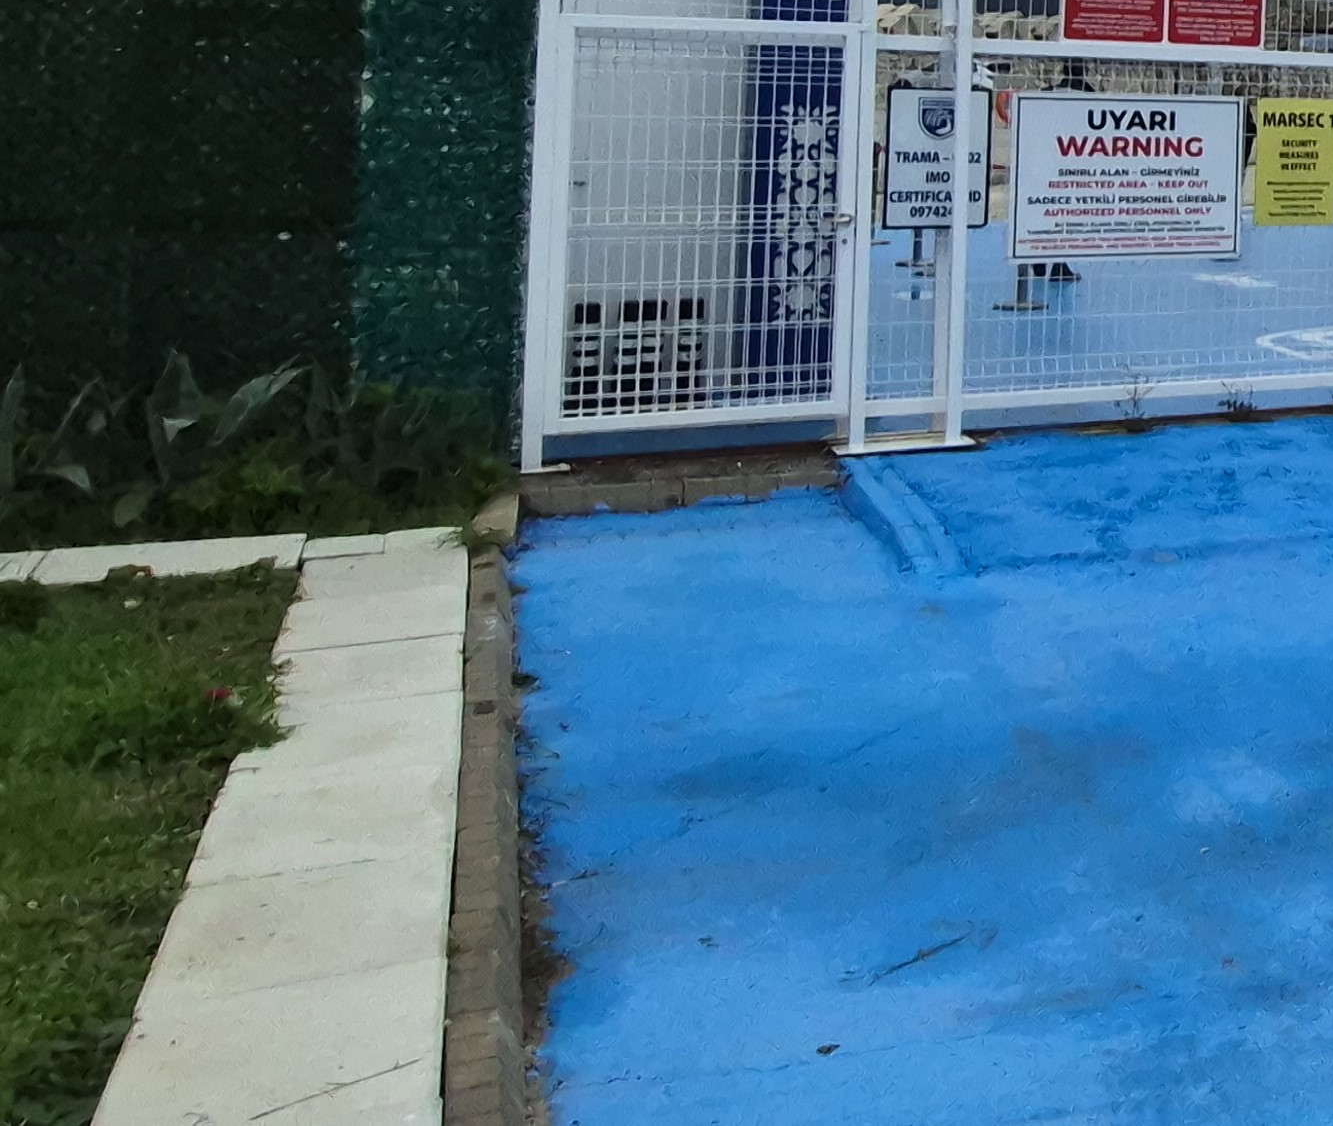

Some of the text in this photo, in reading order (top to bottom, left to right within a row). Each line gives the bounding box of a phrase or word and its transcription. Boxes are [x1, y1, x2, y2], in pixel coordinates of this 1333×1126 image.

[1087, 109, 1176, 131] UYARI
[1263, 112, 1324, 128] MARSEC
[1057, 136, 1203, 157] WARNING
[1282, 139, 1317, 147] SECURITY
[895, 152, 940, 163] TRAMA
[926, 171, 950, 183] IMO
[1100, 168, 1129, 177] ALAN
[1048, 180, 1114, 189] RESTRICTED
[1119, 180, 1147, 189] AREA
[1158, 180, 1185, 189] KEEP
[1188, 180, 1208, 189] OUT
[889, 191, 981, 203] CERTIFICA ID
[1027, 195, 1071, 205] SADECE
[1075, 193, 1115, 205] YETKİLİ
[1119, 195, 1174, 204] PERSONEL
[1044, 207, 1212, 217] AUTHORIZED PERSONNEL ONLY
